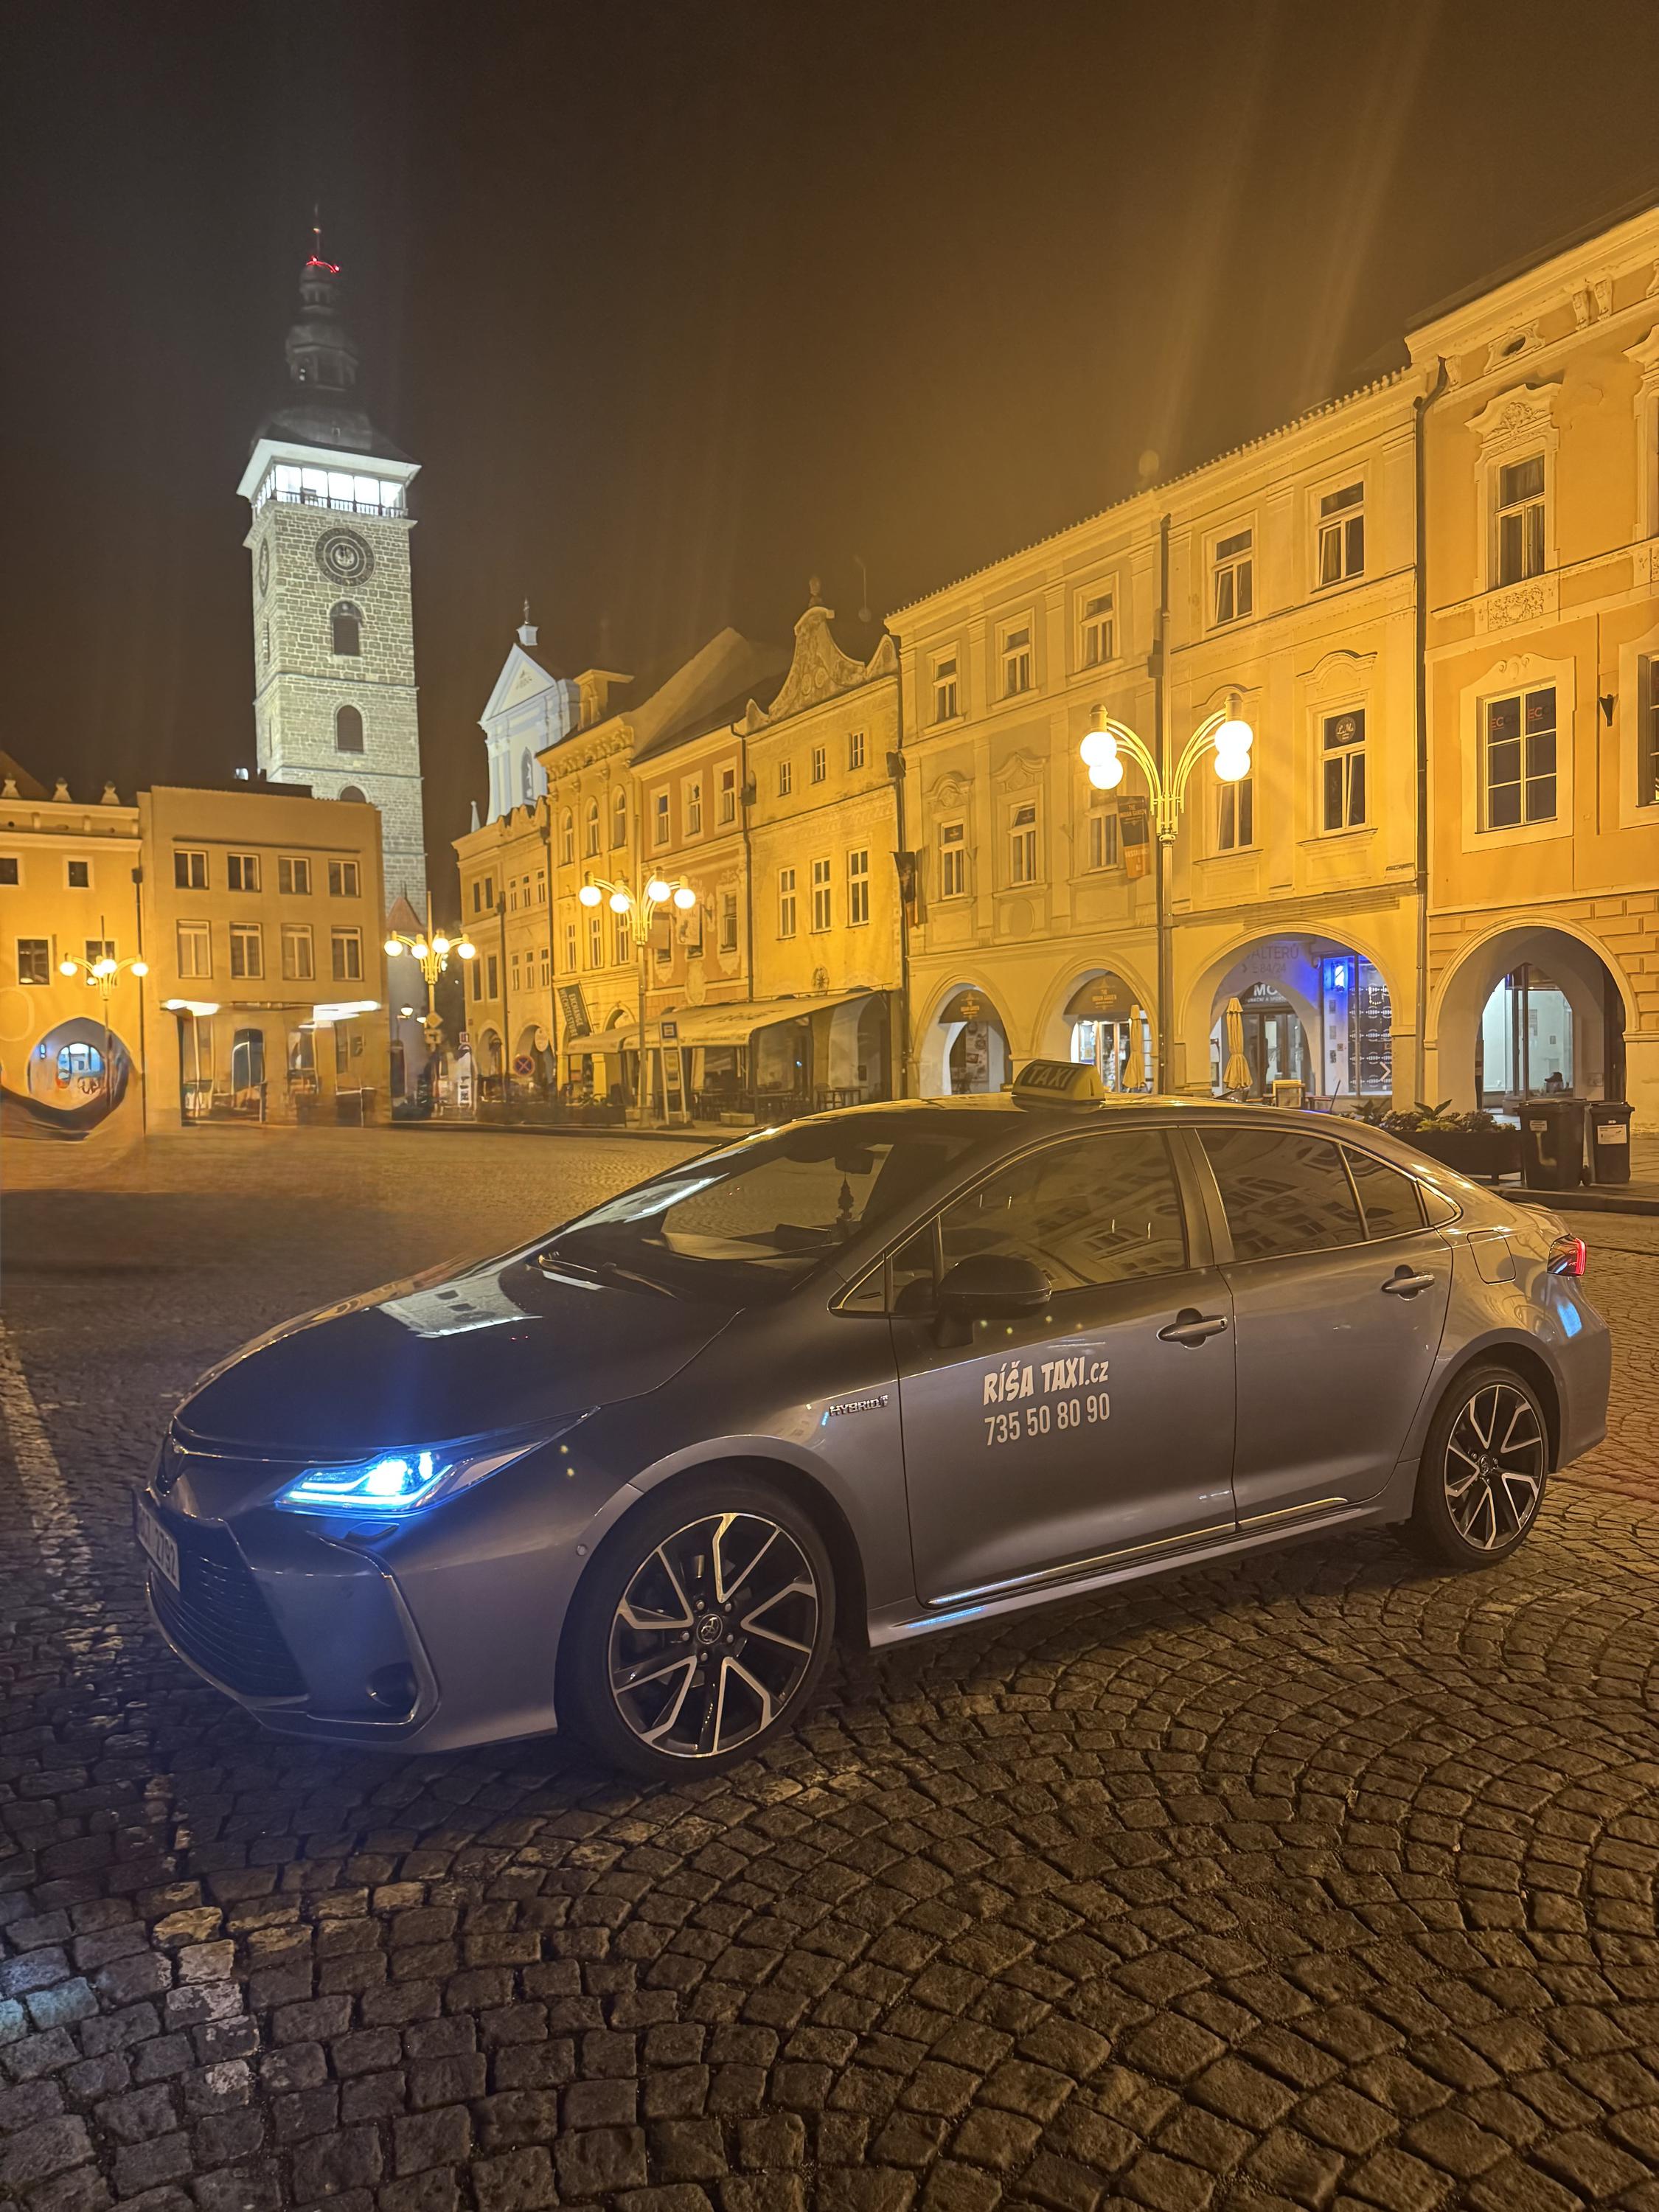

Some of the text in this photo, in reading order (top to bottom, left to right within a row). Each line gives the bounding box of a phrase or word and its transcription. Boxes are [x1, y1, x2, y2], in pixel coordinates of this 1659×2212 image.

[568, 992, 584, 1026] EXCHANGE
[1028, 1065, 1074, 1088] TAXI
[984, 1356, 1109, 1405] RÍŠA TAXI.cz
[830, 1398, 881, 1416] HYBRID
[984, 1392, 1110, 1446] 735 50 80 90
